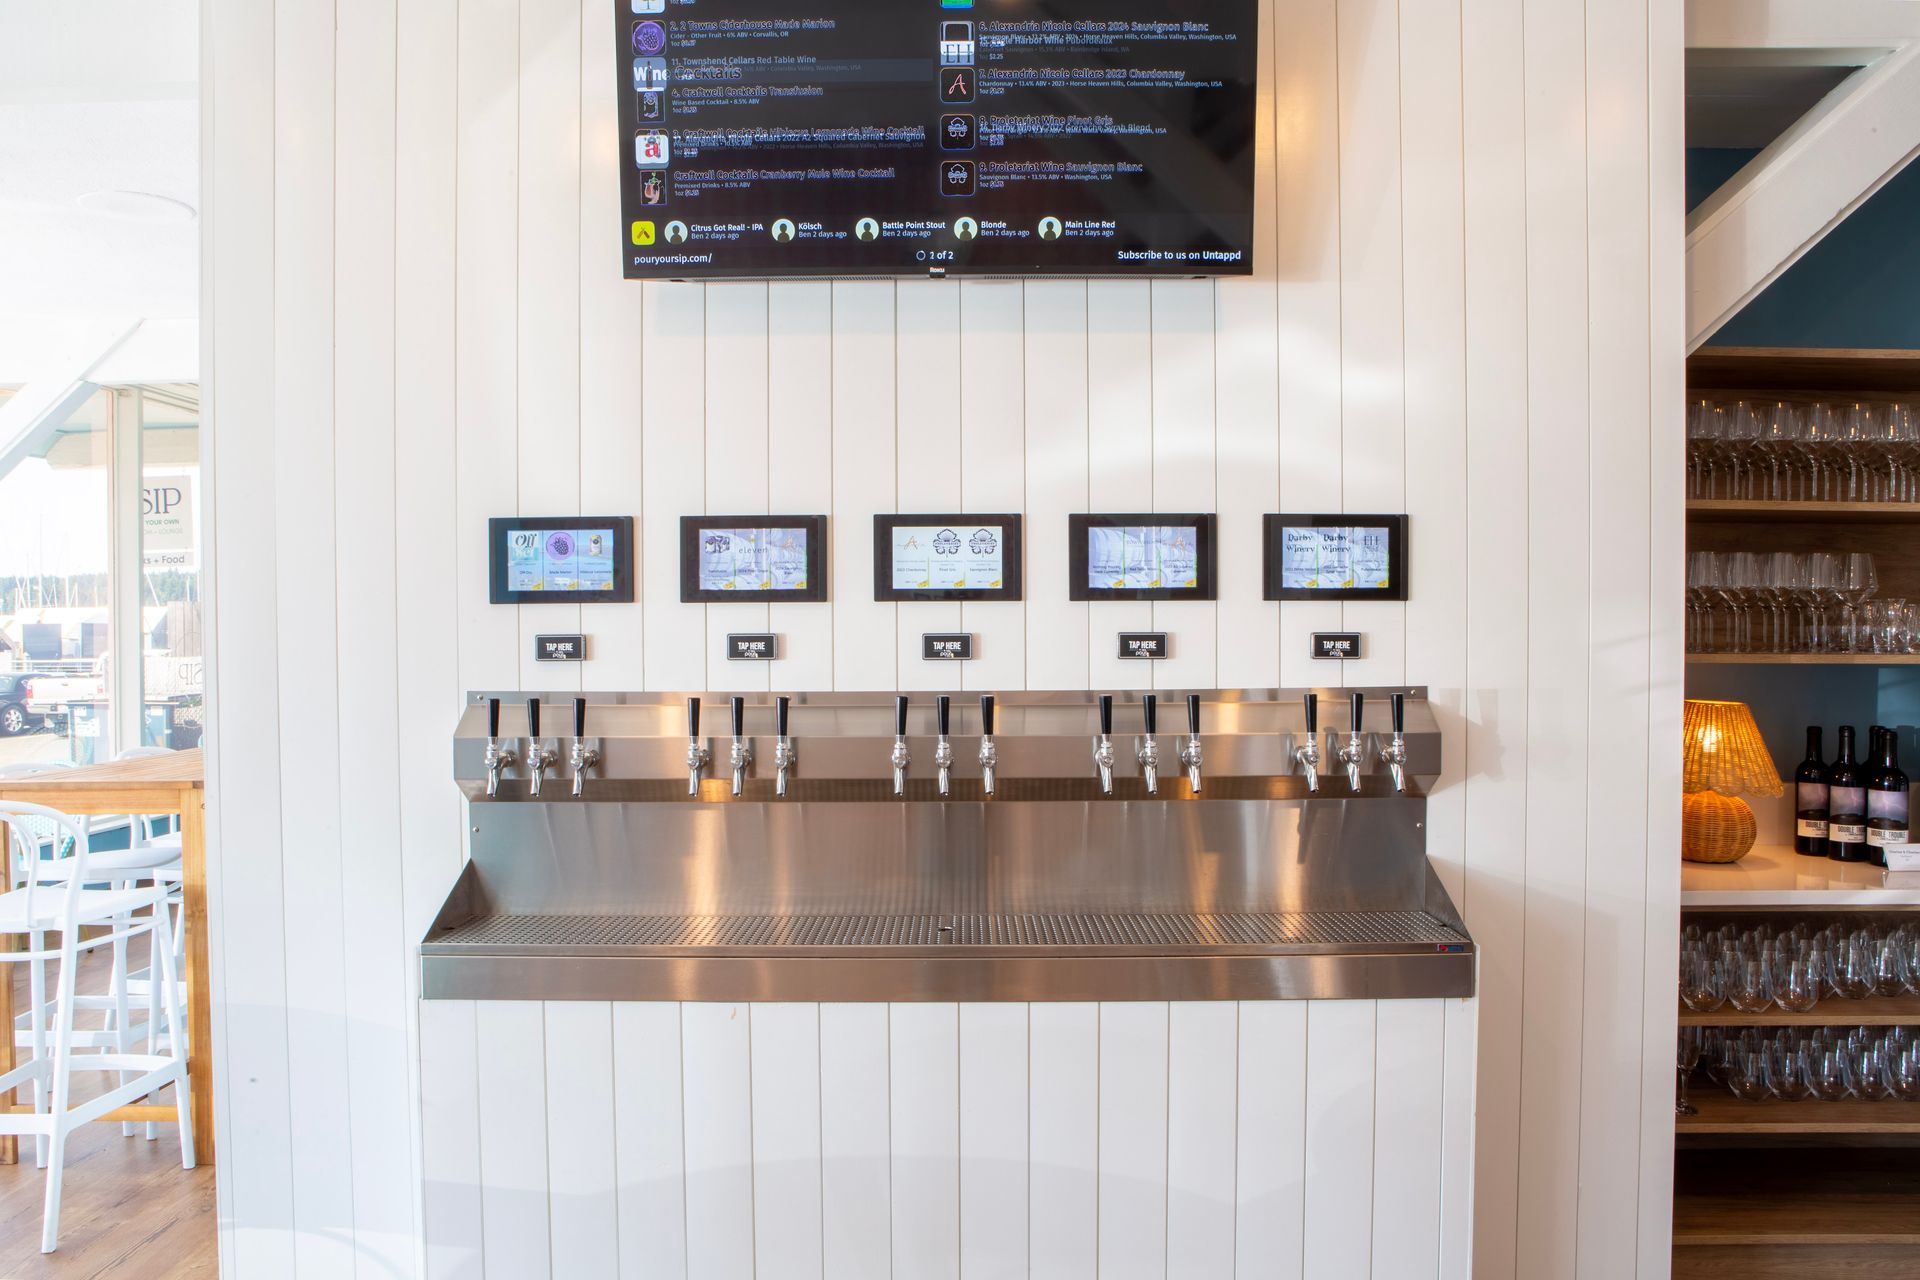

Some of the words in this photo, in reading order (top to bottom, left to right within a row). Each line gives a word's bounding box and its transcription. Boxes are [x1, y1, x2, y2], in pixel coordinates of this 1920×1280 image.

[670, 21, 678, 32] 2.
[680, 21, 687, 32] 2
[688, 20, 718, 31] Towns
[720, 18, 773, 30] Ciderhouse
[774, 19, 801, 30] Made
[979, 22, 988, 32] 6.
[990, 20, 1040, 32] Alexandria
[1042, 20, 1072, 32] Nicole
[1073, 20, 1107, 31] Cellars
[1131, 21, 1180, 34] Sauvignon
[1182, 22, 1209, 32] Blanc
[753, 31, 780, 39] Corvallis,
[1169, 34, 1187, 42] Valley,
[1188, 34, 1224, 42] Washington,
[671, 58, 680, 66] 11.
[683, 56, 727, 66] Townshend
[728, 56, 756, 65] Cellars
[757, 56, 772, 64] Red
[774, 56, 795, 64] Table
[796, 55, 817, 64] Wine
[634, 65, 672, 82] Wine
[675, 64, 742, 80] Cocktails
[979, 69, 987, 79] 7.
[988, 68, 1039, 79] Alexandria
[1040, 68, 1070, 79] Nicole
[1072, 68, 1104, 78] Cellars
[1128, 69, 1186, 80] Chardonnay
[671, 88, 680, 98] 4.
[682, 87, 723, 98] Craftwell
[724, 86, 768, 97] Cocktails
[990, 115, 1040, 126] Proletariat
[1041, 116, 1066, 125] Wine
[979, 162, 988, 172] 9.
[990, 162, 1039, 172] Proletariat
[1040, 162, 1064, 172] Wine
[1066, 162, 1115, 174] Sauvignon
[1116, 162, 1143, 172] Blanc
[674, 170, 716, 181] Craftwell
[716, 168, 758, 180] Cocktails
[808, 168, 831, 179] Mule
[832, 168, 856, 178] Wine
[858, 168, 896, 178] Cocktail
[690, 224, 712, 232] Citrus
[713, 224, 726, 232] Got
[798, 222, 822, 230] Kölsch
[926, 221, 946, 229] Stout
[980, 220, 1007, 229] Blonde
[1065, 220, 1083, 228] Main
[1084, 220, 1100, 228] Line
[1101, 220, 1116, 228] Red
[691, 232, 704, 240] Ben
[710, 232, 726, 240] days
[818, 230, 834, 239] days
[902, 230, 918, 238] days
[1000, 229, 1016, 237] days
[1017, 230, 1030, 238] ago
[1084, 228, 1100, 237] days
[634, 253, 713, 266] pouryoursip.com/
[936, 250, 947, 260] of
[948, 251, 954, 260] 2
[1118, 250, 1162, 260] Subscribe
[1164, 250, 1174, 260] to
[1176, 252, 1186, 260] us
[1188, 252, 1200, 260] on
[1202, 250, 1242, 262] Untappd
[144, 487, 182, 515] SIP
[162, 554, 184, 564] Food
[546, 642, 557, 651] TAP
[558, 642, 573, 651] HERE
[738, 642, 750, 650] TAP
[750, 642, 766, 650] HERE
[933, 642, 945, 650] TAP
[946, 642, 962, 650] HERE
[1128, 640, 1140, 649] TAP
[1141, 640, 1156, 649] HERE
[1322, 640, 1334, 649] TAP
[1335, 640, 1350, 649] HERE
